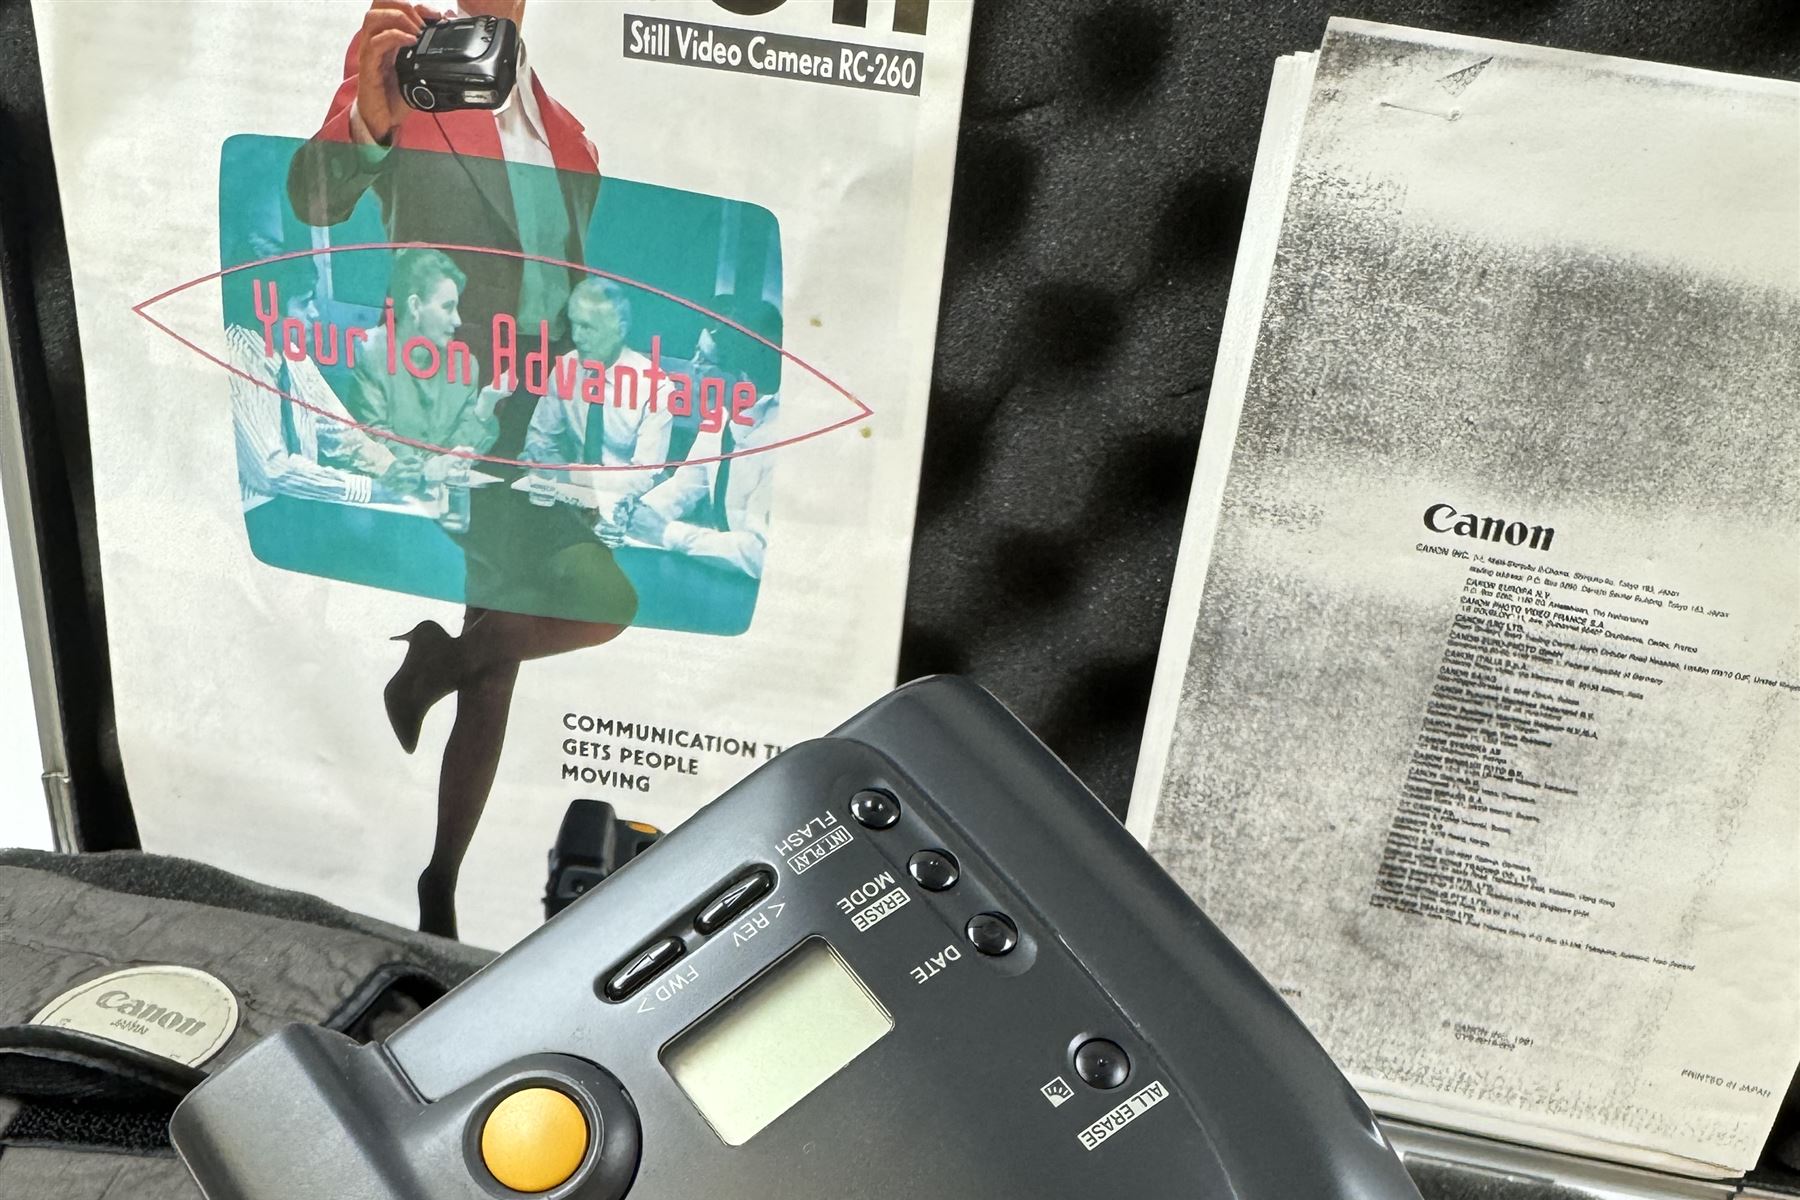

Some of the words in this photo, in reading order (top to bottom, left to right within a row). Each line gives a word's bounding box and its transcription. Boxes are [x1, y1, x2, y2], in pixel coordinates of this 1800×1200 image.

[629, 19, 670, 57] Still
[676, 26, 742, 67] Video
[747, 36, 833, 78] Camera
[839, 48, 916, 89] RC-260
[253, 279, 368, 368] Your
[492, 312, 757, 432] Advantage
[1423, 503, 1555, 551] Canon
[562, 738, 611, 761] GETS
[620, 746, 699, 775] PEOPLE
[563, 713, 756, 759] COMMUNICATION
[562, 764, 650, 792] MOVING
[775, 810, 837, 856] FLASH
[793, 844, 826, 871] PLAY
[836, 871, 895, 914] MODE
[853, 890, 908, 931] ERASE
[733, 912, 770, 947] REV
[655, 965, 699, 1001] FWD
[910, 944, 962, 985] DATE
[96, 990, 207, 1037] Canon
[1131, 1083, 1163, 1108] ALL
[1081, 1103, 1135, 1147] ERASE
